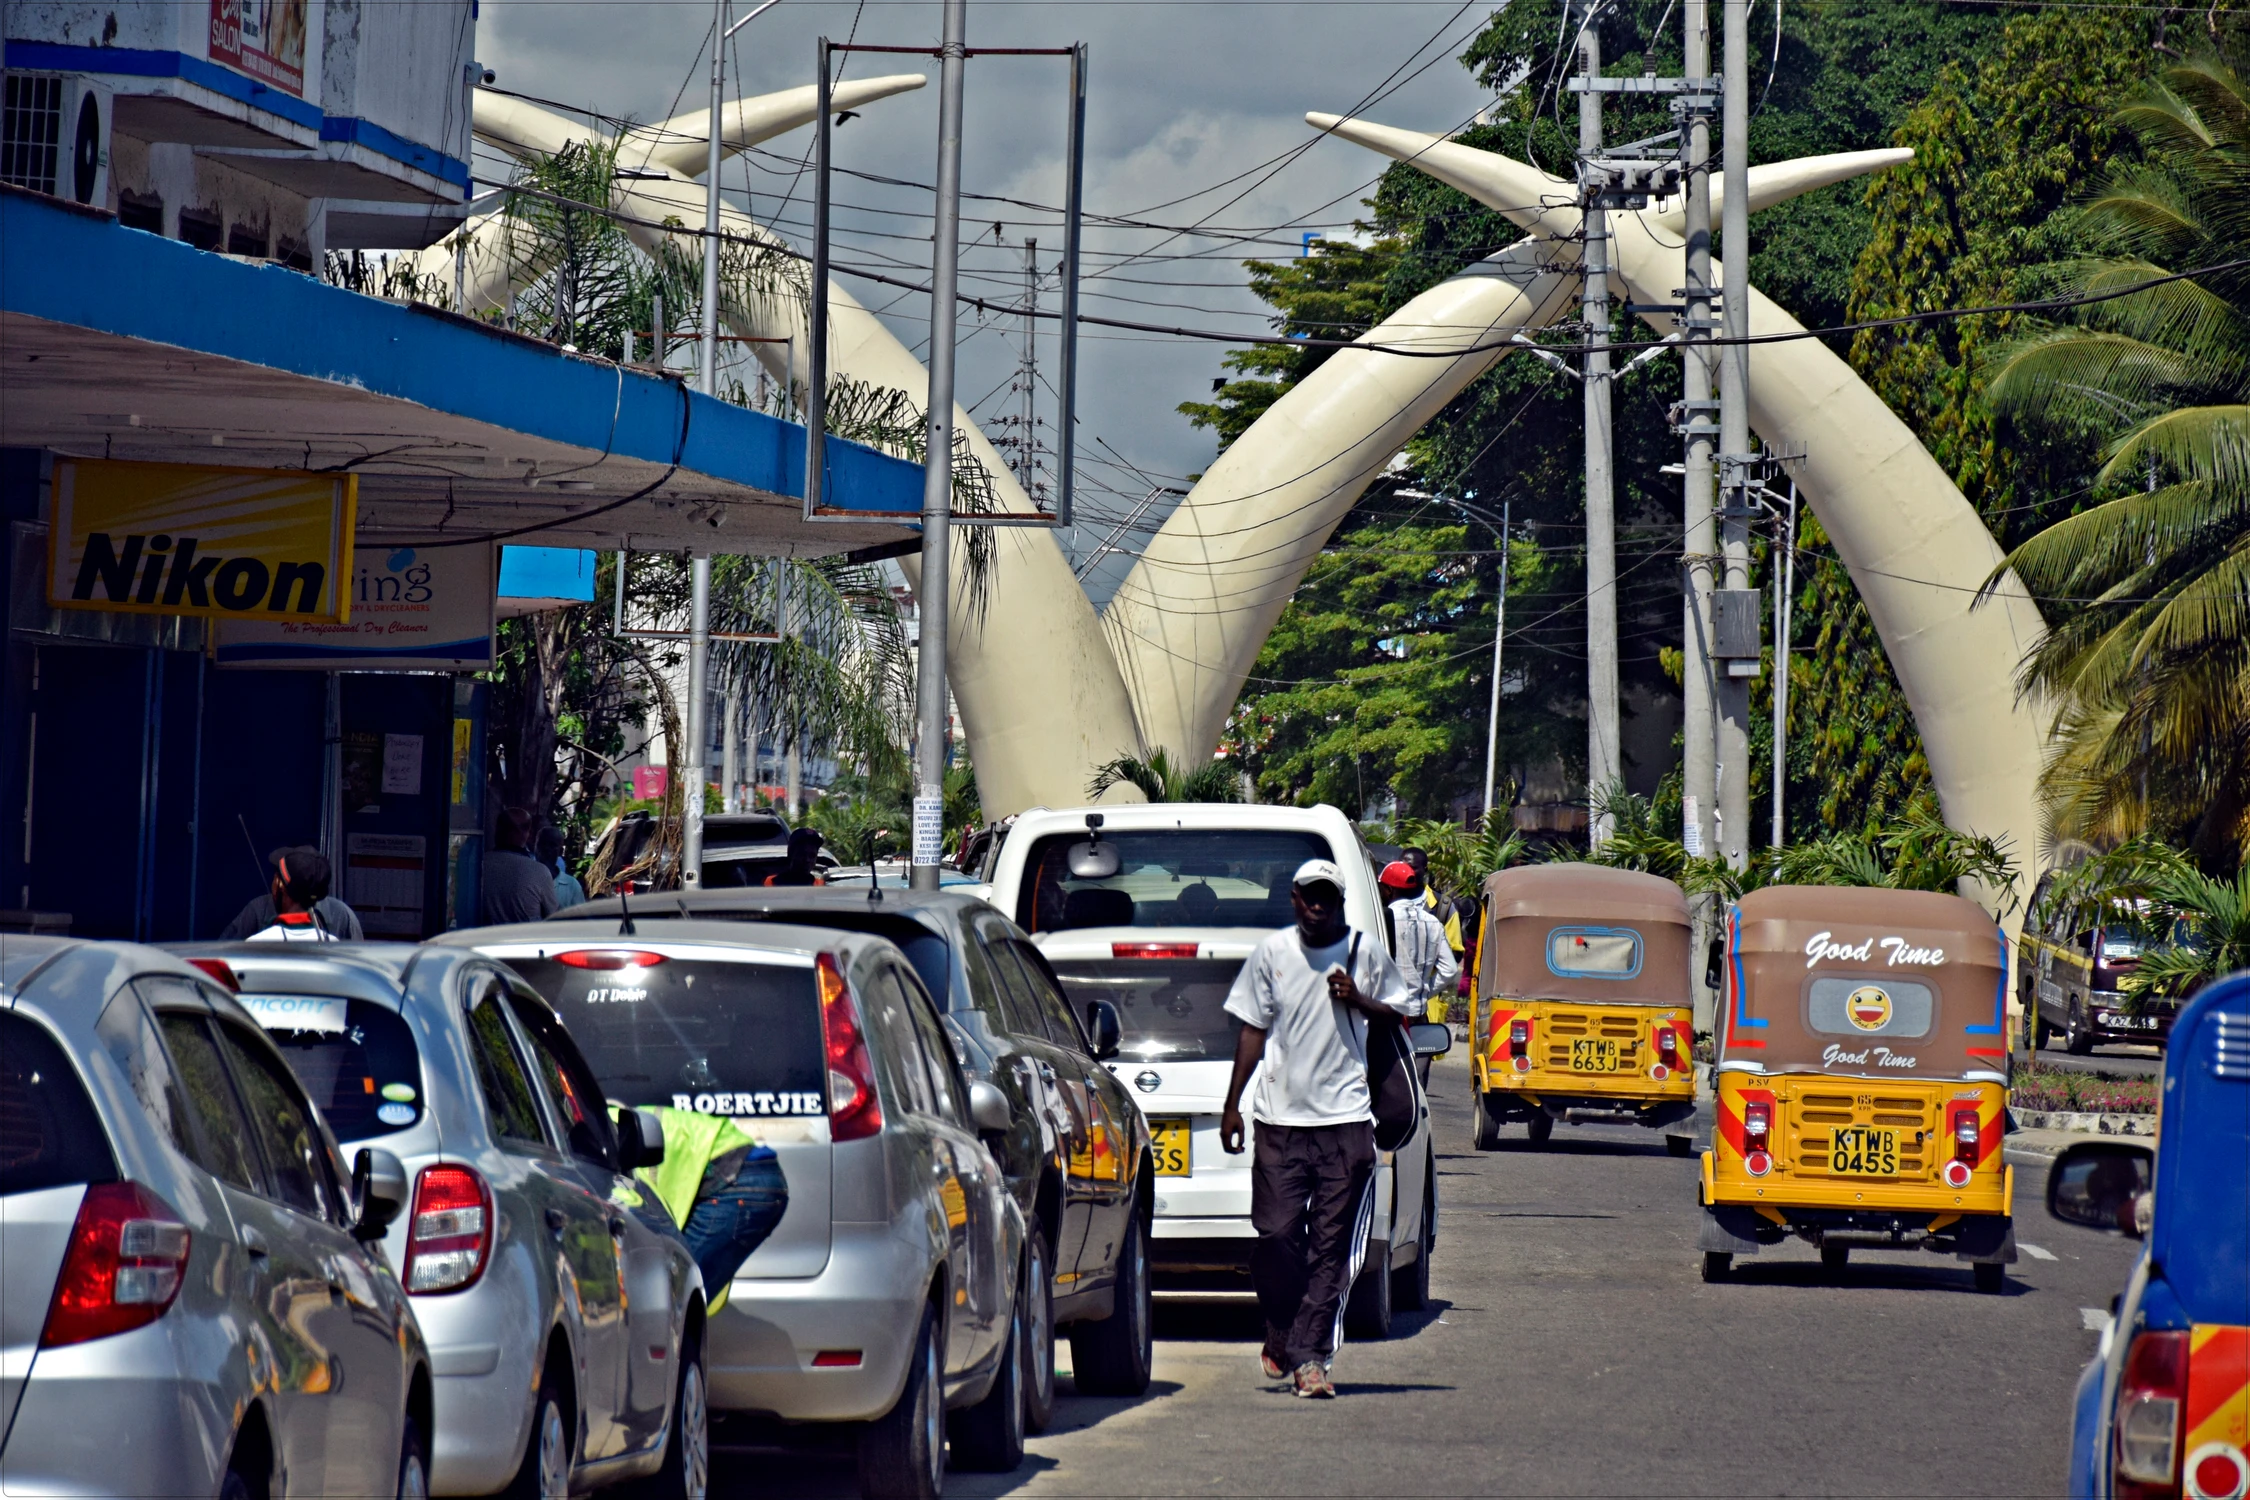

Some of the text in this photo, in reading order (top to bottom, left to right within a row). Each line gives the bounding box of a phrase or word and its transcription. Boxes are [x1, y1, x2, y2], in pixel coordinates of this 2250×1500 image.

[212, 19, 241, 56] SALON
[72, 533, 325, 613] Nikon
[352, 563, 433, 603] ing
[367, 604, 372, 612] &
[374, 604, 430, 612] DRYCLEANERS
[281, 621, 429, 636] The Professional Dry Cleaners
[914, 857, 930, 865] 0722
[1805, 932, 1945, 968] Good Time
[587, 988, 608, 1004] DT
[1590, 1018, 1600, 1026] 65
[1853, 1017, 1888, 1029] Good Time
[1573, 1039, 1616, 1056] KTWB
[1823, 1043, 1917, 1068] Good Time
[1573, 1054, 1617, 1072] 663J
[1748, 1078, 1770, 1087] PSV
[672, 1091, 823, 1115] BOERTJIE
[1857, 1094, 1872, 1106] 65
[1834, 1128, 1894, 1153] KTWB
[1833, 1151, 1896, 1175] 045S
